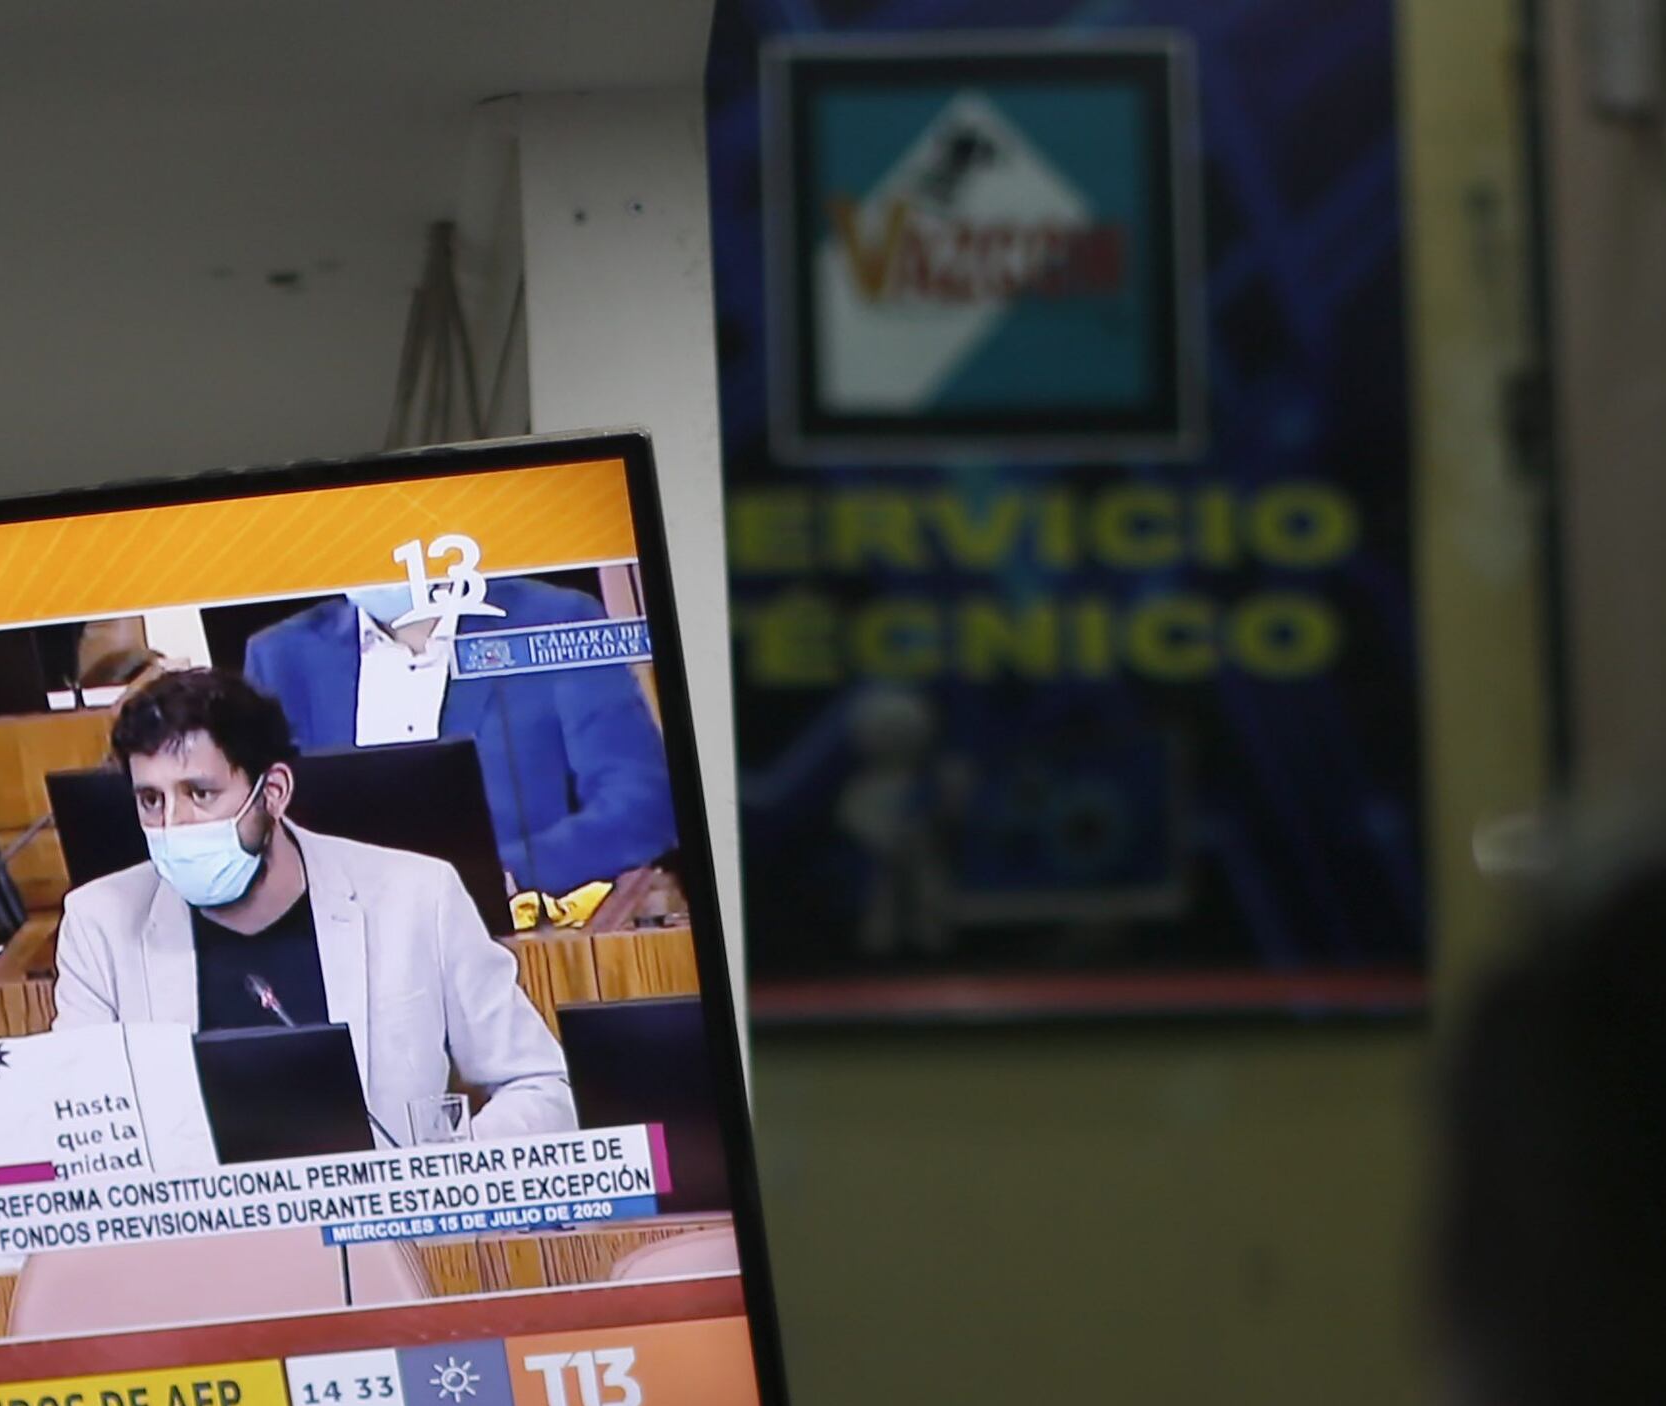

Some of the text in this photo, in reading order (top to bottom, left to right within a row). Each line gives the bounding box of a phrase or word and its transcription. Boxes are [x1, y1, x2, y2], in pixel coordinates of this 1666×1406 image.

[392, 534, 487, 614] 13
[536, 628, 615, 648] CÁMARA
[537, 640, 641, 664] DIPUTADAS
[731, 588, 1343, 684] ÉCNICO
[54, 1094, 132, 1121] Hasta
[57, 1121, 138, 1152] que la
[108, 1167, 301, 1209] CONSTITUCIONAL
[307, 1157, 403, 1190] PERMITE
[410, 1149, 505, 1180] RETIRAR
[513, 1141, 587, 1171] PARTE
[593, 1137, 624, 1161] DE
[97, 1198, 272, 1244] PREVISIONALES
[278, 1190, 383, 1226] DURANTE
[390, 1182, 480, 1215] ESTADO
[487, 1178, 517, 1204] DE
[522, 1165, 651, 1201] EXCEPCIÓN
[332, 1201, 613, 1243] MIÉRCOLES 15 DE JULIO DE 2020
